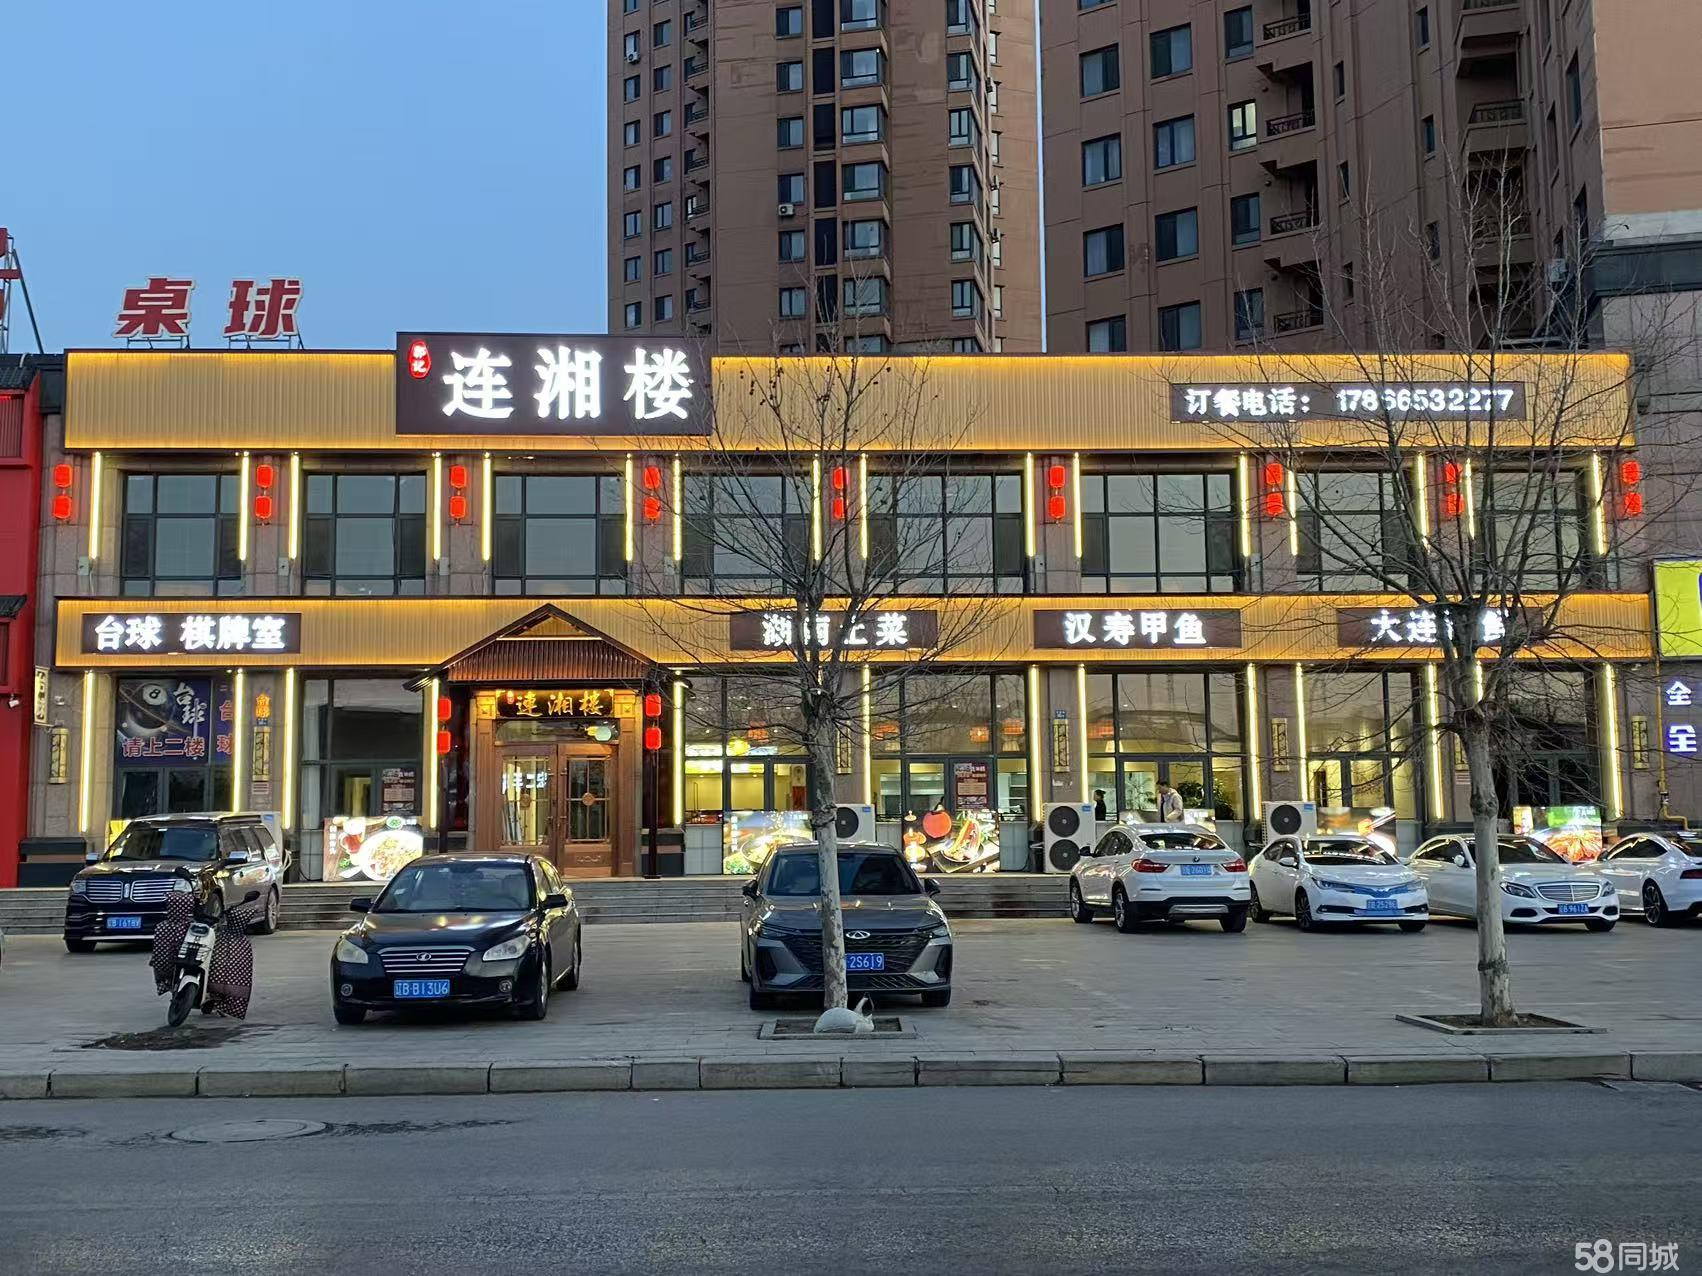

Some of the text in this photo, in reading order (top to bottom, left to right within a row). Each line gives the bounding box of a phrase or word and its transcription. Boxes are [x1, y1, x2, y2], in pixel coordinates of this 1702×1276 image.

[113, 275, 303, 338] 桌球
[442, 345, 693, 420] 连湘楼
[1335, 388, 1514, 412] 17866532277
[95, 615, 286, 650] 台球 棋牌室
[1064, 611, 1207, 645] 汉寿甲鱼
[1370, 608, 1509, 643] 大连鲜
[174, 682, 208, 725] 台球
[122, 736, 205, 757] 请上二楼
[849, 955, 883, 968] 2S619
